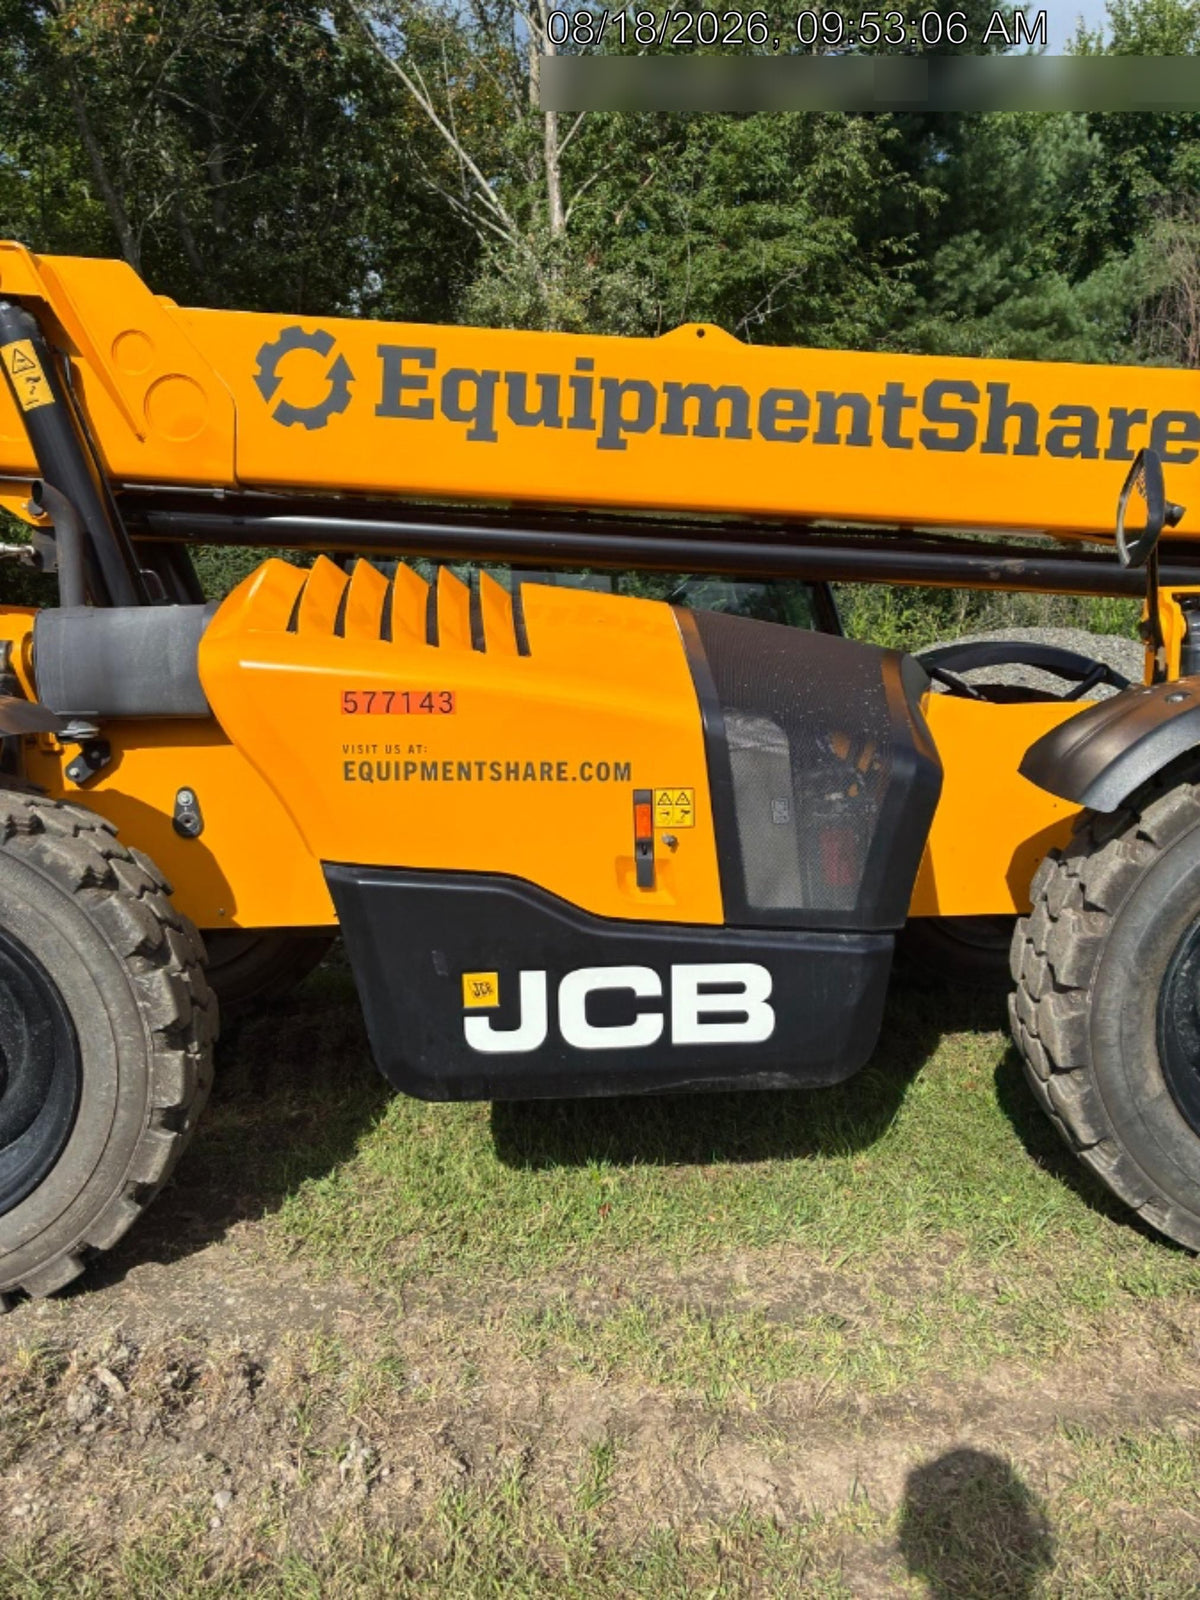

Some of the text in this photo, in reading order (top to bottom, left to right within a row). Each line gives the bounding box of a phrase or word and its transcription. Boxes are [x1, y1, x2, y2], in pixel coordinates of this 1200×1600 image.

[375, 344, 1200, 464] EquipmentShare
[343, 691, 454, 714] 577143
[342, 744, 428, 754] VISIT US AT:
[343, 760, 632, 783] EQUIPMENTSHARE.COM
[463, 963, 776, 1054] JCB
